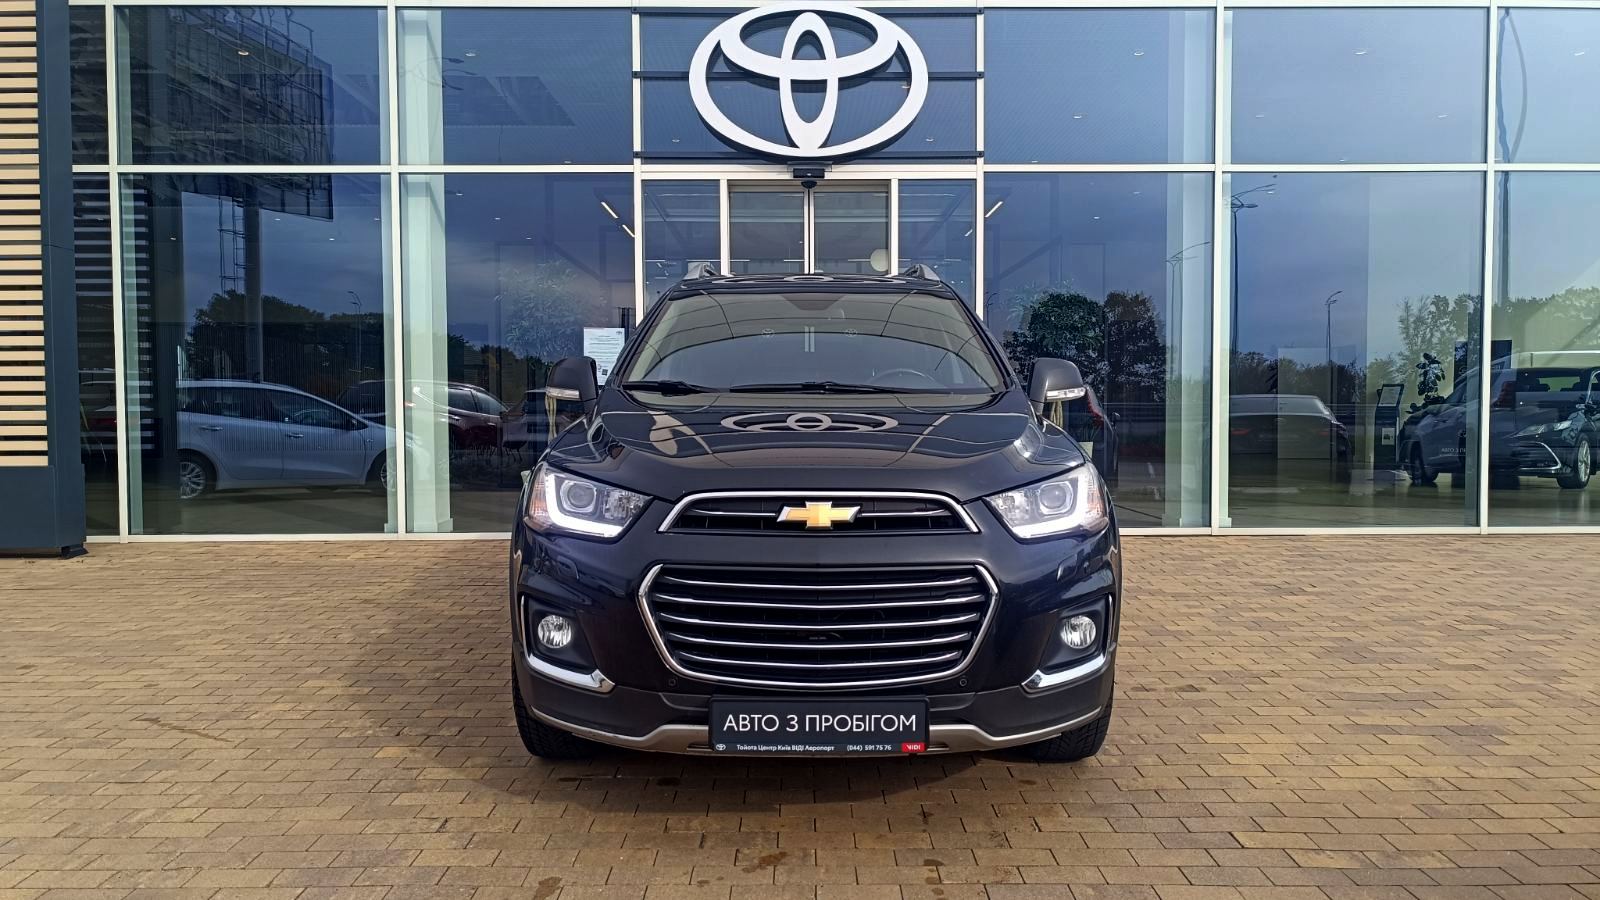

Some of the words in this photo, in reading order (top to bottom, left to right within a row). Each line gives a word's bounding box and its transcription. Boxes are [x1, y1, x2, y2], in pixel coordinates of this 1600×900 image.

[723, 714, 779, 732] АВТО
[786, 714, 799, 732] З
[805, 714, 916, 732] ПРОБІГОМ
[758, 744, 777, 752] Центр
[804, 744, 835, 752] Аеропорт
[846, 744, 863, 752] (044)
